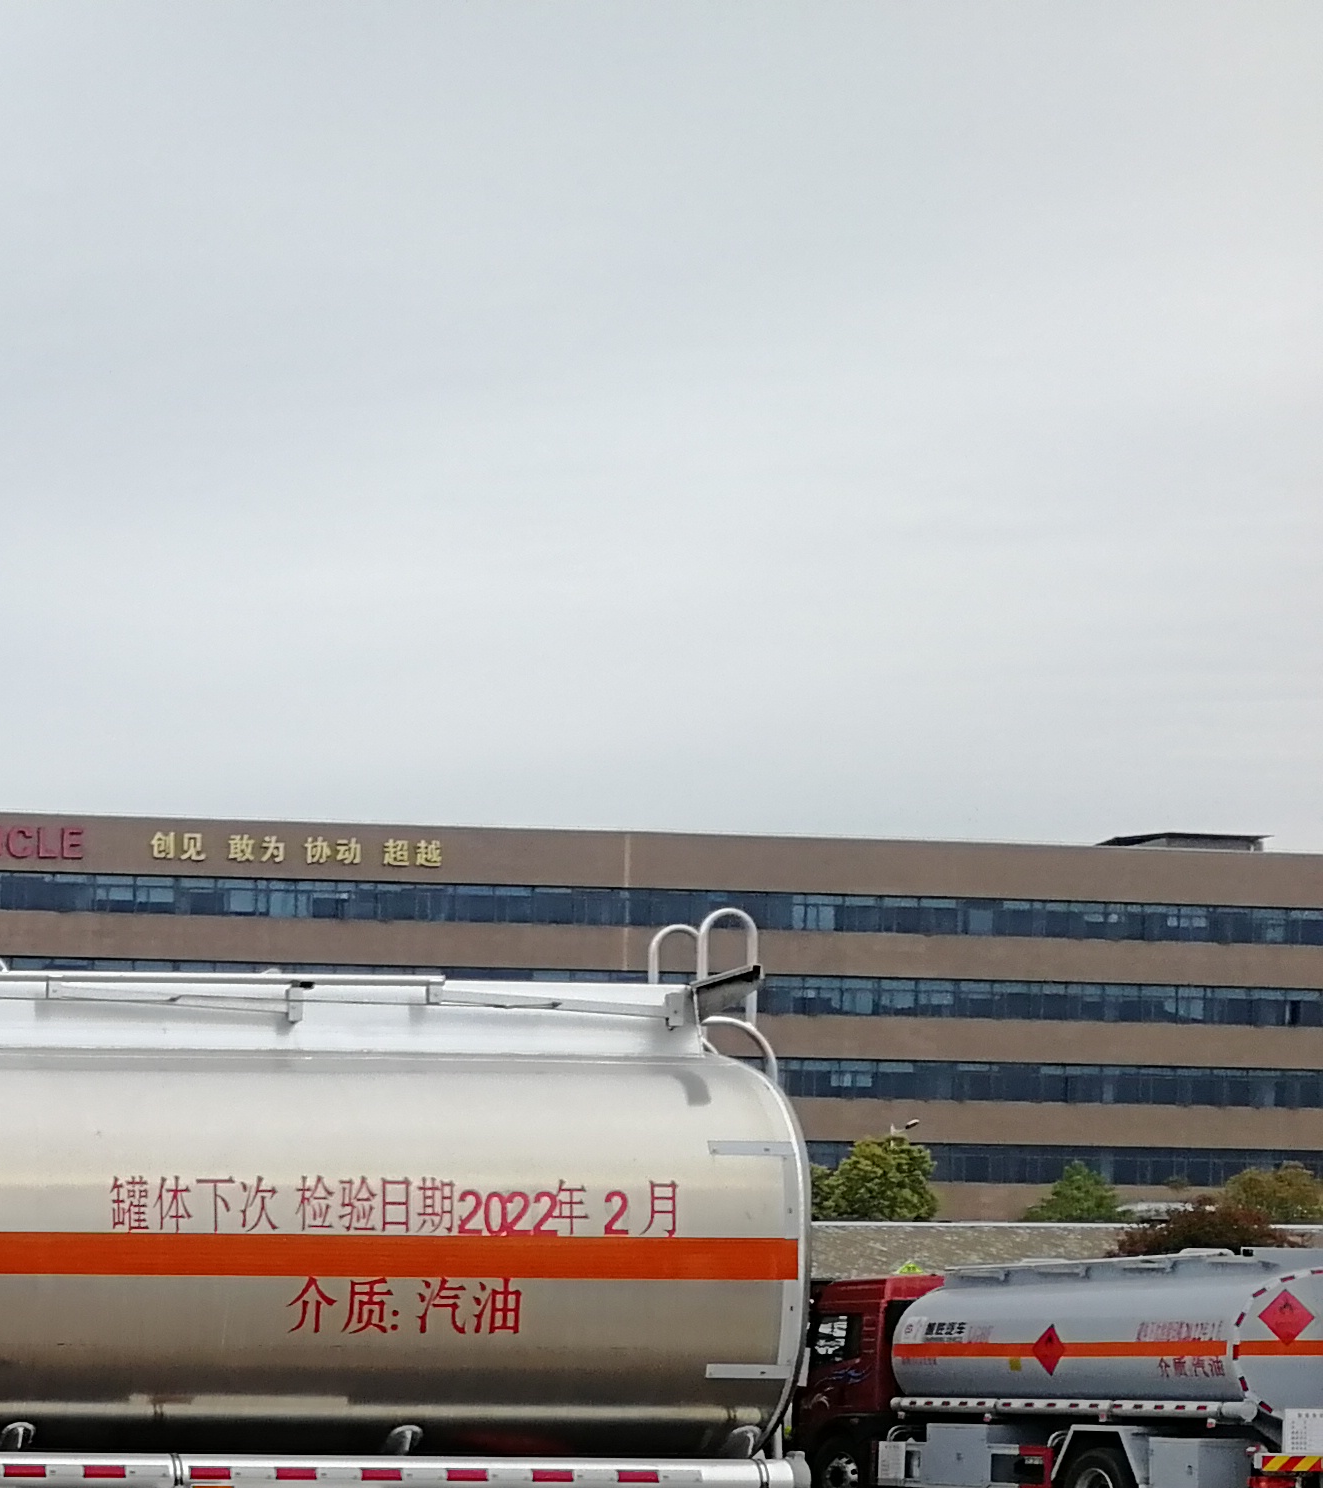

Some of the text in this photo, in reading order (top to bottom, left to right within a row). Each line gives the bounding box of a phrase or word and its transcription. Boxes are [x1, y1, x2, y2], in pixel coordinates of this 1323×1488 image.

[151, 831, 443, 867] 创见 敢为 协动 超越
